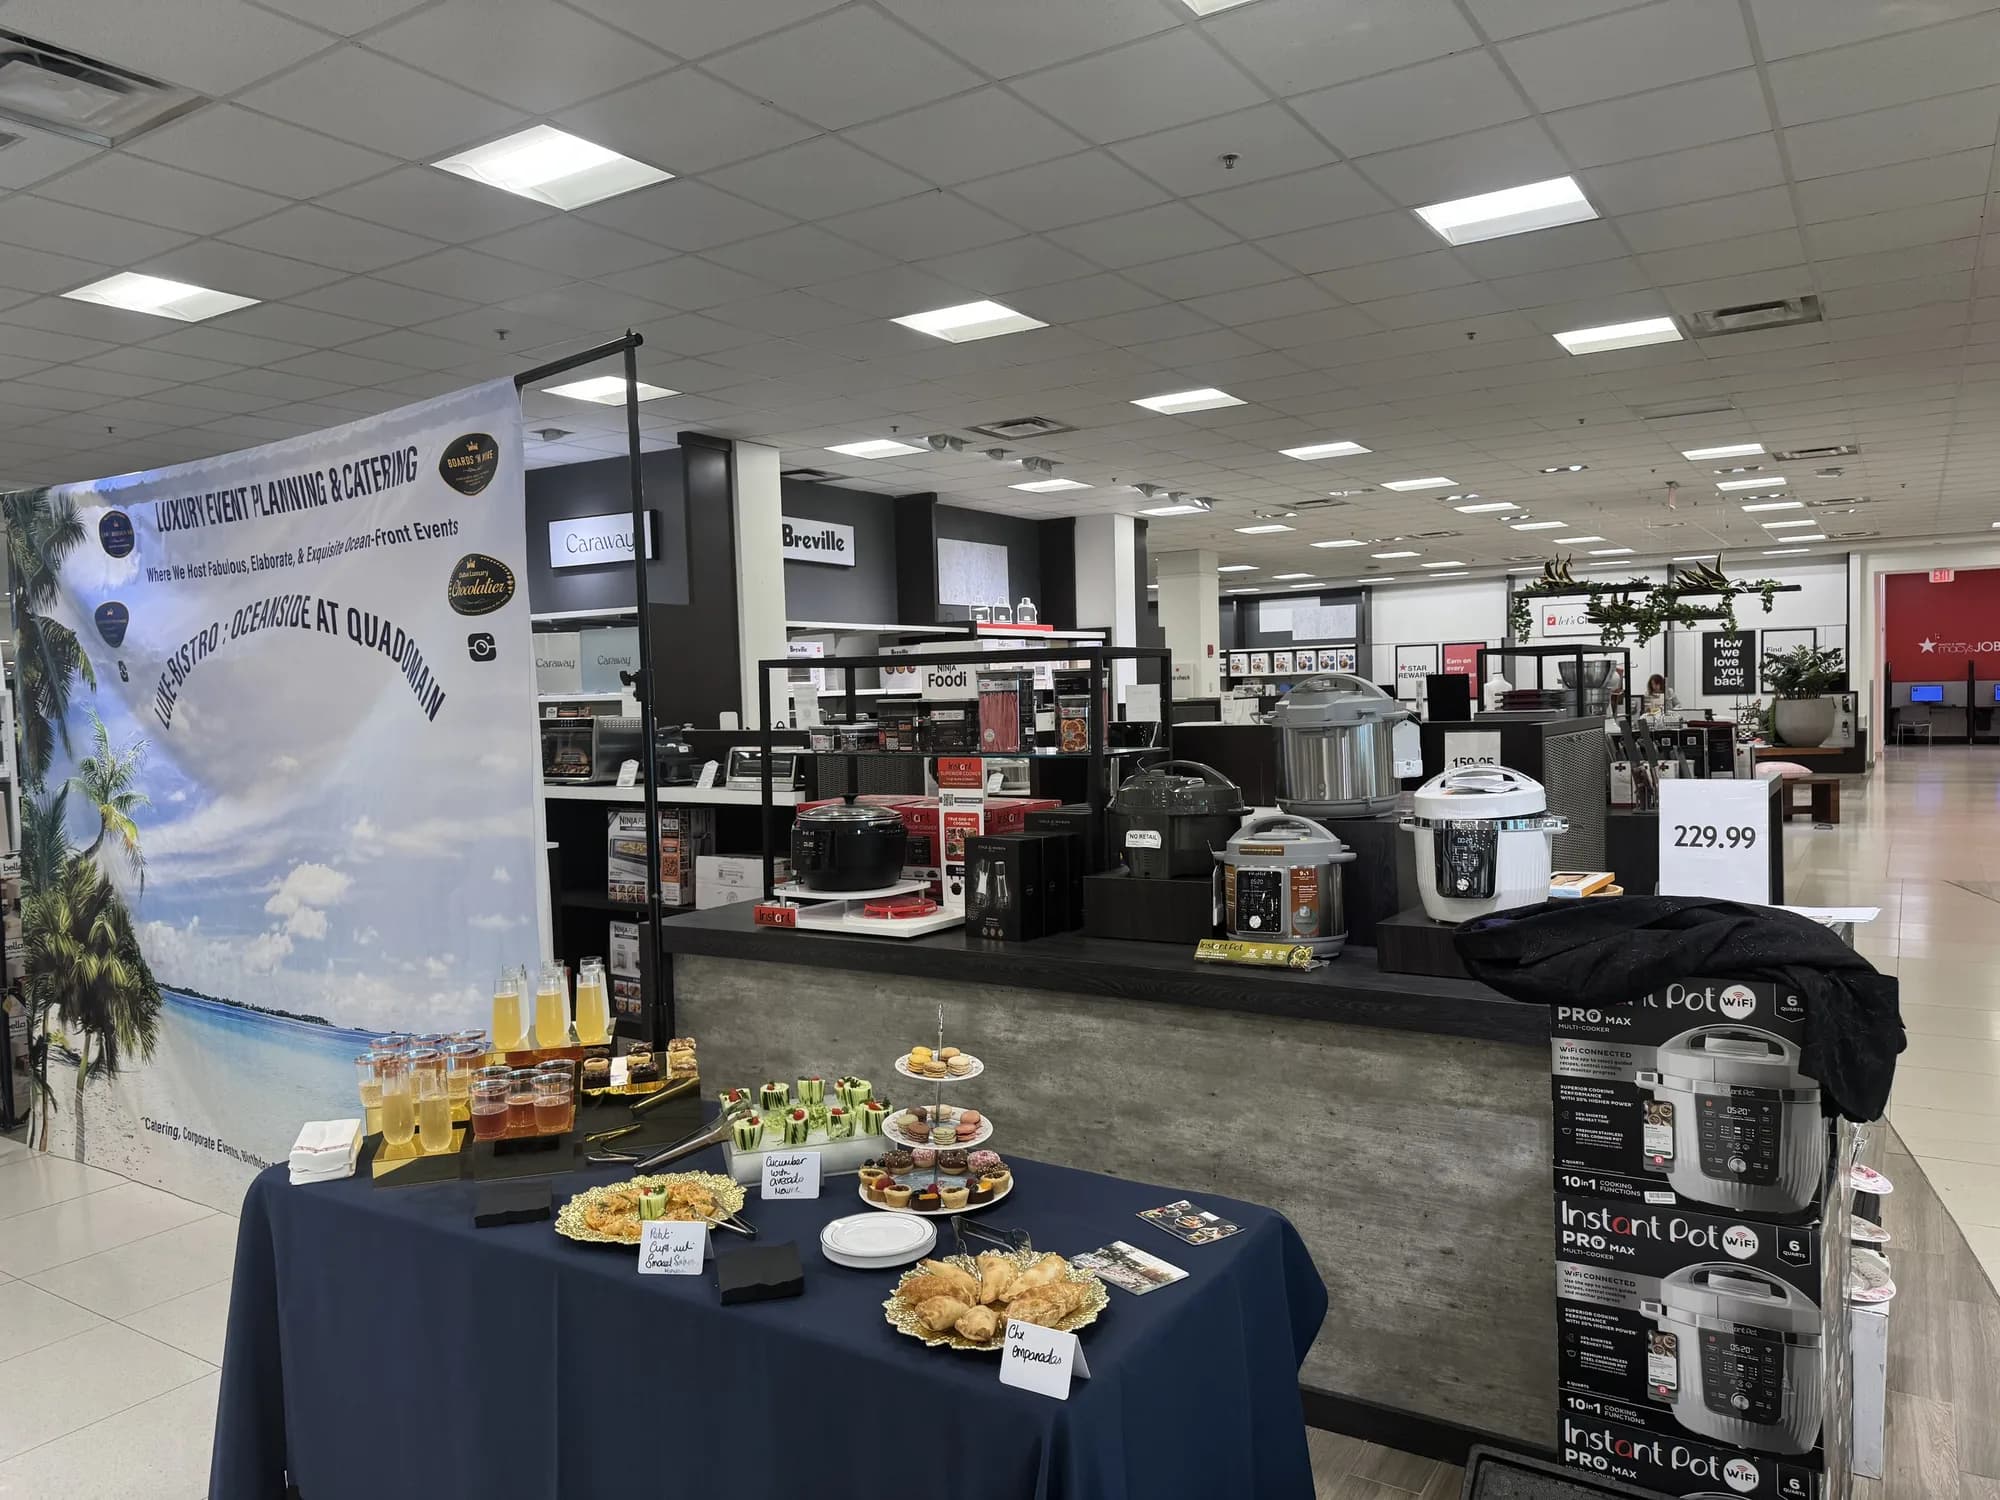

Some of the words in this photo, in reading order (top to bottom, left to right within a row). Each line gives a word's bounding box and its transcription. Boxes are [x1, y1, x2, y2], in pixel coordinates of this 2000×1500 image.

[447, 455, 474, 468] BOARDS
[155, 495, 206, 532] LUXURY
[208, 488, 249, 524] EVENT
[250, 471, 328, 517] PLANNING
[329, 468, 343, 502] &
[343, 446, 418, 499] CATERING
[566, 530, 634, 554] Caraway
[782, 523, 845, 553] Breville
[147, 568, 172, 583] Where
[172, 565, 186, 580] We
[187, 563, 207, 579] Host
[208, 559, 250, 577] Fabulous,
[250, 551, 296, 572] Elaborate,
[298, 548, 305, 562] &
[307, 540, 344, 563] Exquisite
[344, 524, 412, 552] Ocean-Front
[413, 519, 459, 540] Events
[451, 577, 506, 598] Chocolatier
[1714, 638, 1743, 649] How
[1721, 649, 1740, 657] we
[155, 622, 219, 730] LUXE-BISTRO
[231, 594, 311, 640] OCEANSIDE
[317, 598, 339, 635] AT
[347, 606, 446, 722] QUADOMAIN
[536, 658, 575, 670] Caraway
[597, 655, 632, 667] Caraway
[1714, 657, 1739, 667] love
[1721, 667, 1744, 678] you
[927, 671, 968, 688] Foodi
[619, 815, 638, 827] NINJA
[1674, 825, 1756, 849] 229.99
[759, 908, 791, 923] Instant
[1666, 983, 1717, 1013] Pot
[1722, 996, 1753, 1009] WiFi
[1786, 995, 1798, 1006] 6
[1780, 1005, 1804, 1013] QUARTS
[1558, 1006, 1602, 1024] PRO
[1605, 1016, 1632, 1026] MAX
[1558, 1022, 1610, 1033] MULTI-COOKER
[1560, 1046, 1578, 1054] WiFi
[1578, 1047, 1632, 1059] CONNECTED
[1560, 1084, 1588, 1092] SUPERIOR
[1588, 1087, 1615, 1095] COOKING
[1560, 1089, 1602, 1099] PERFORMANCE
[182, 1127, 216, 1151] Corporate
[217, 1139, 242, 1162] Events,
[1599, 1180, 1633, 1190] COOKING
[1599, 1185, 1641, 1197] FUNCTIONS
[1561, 1200, 1662, 1241] Instant
[1669, 1217, 1720, 1250] Pot
[1562, 1230, 1606, 1250] PRO
[1609, 1243, 1636, 1256] MAX
[1724, 1236, 1756, 1249] WiFi
[1789, 1239, 1800, 1251] 6
[1562, 1247, 1615, 1260] MULTI-COOKER
[1782, 1250, 1806, 1259] QUARTS
[1564, 1269, 1582, 1278] WiFi
[1583, 1272, 1636, 1287] CONNECTED
[1603, 1404, 1637, 1417] COOKING
[1604, 1410, 1646, 1425] FUNCTIONS
[1564, 1418, 1663, 1466] Instant
[1671, 1445, 1721, 1481] Pot
[1565, 1447, 1608, 1471] PRO
[1611, 1465, 1638, 1479] MAX
[1726, 1468, 1757, 1483] WiFi
[1789, 1478, 1801, 1490] 6
[1782, 1486, 1807, 1497] QUARTS
